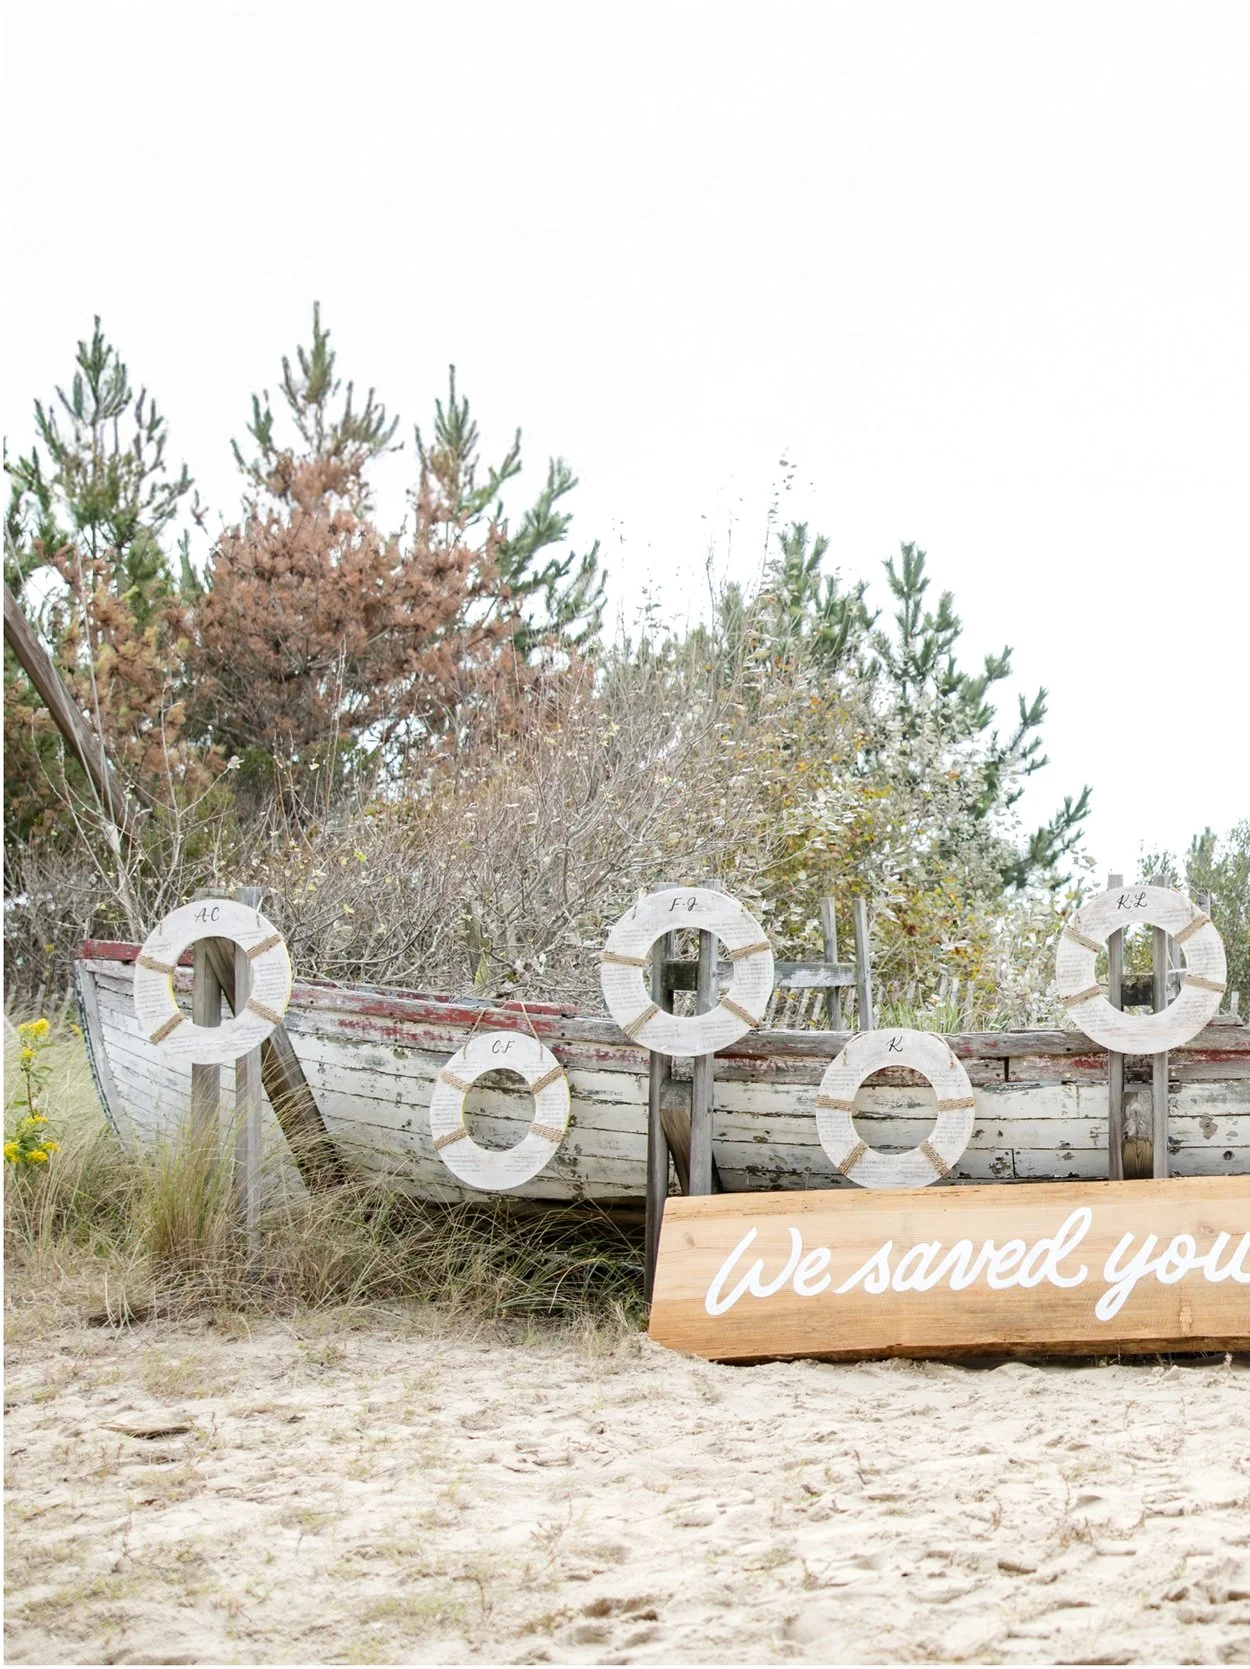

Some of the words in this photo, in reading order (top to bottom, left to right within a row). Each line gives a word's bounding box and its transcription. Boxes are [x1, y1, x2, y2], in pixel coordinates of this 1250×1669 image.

[886, 1035, 904, 1052] K
[704, 1224, 833, 1317] We
[833, 1205, 1096, 1296] saved
